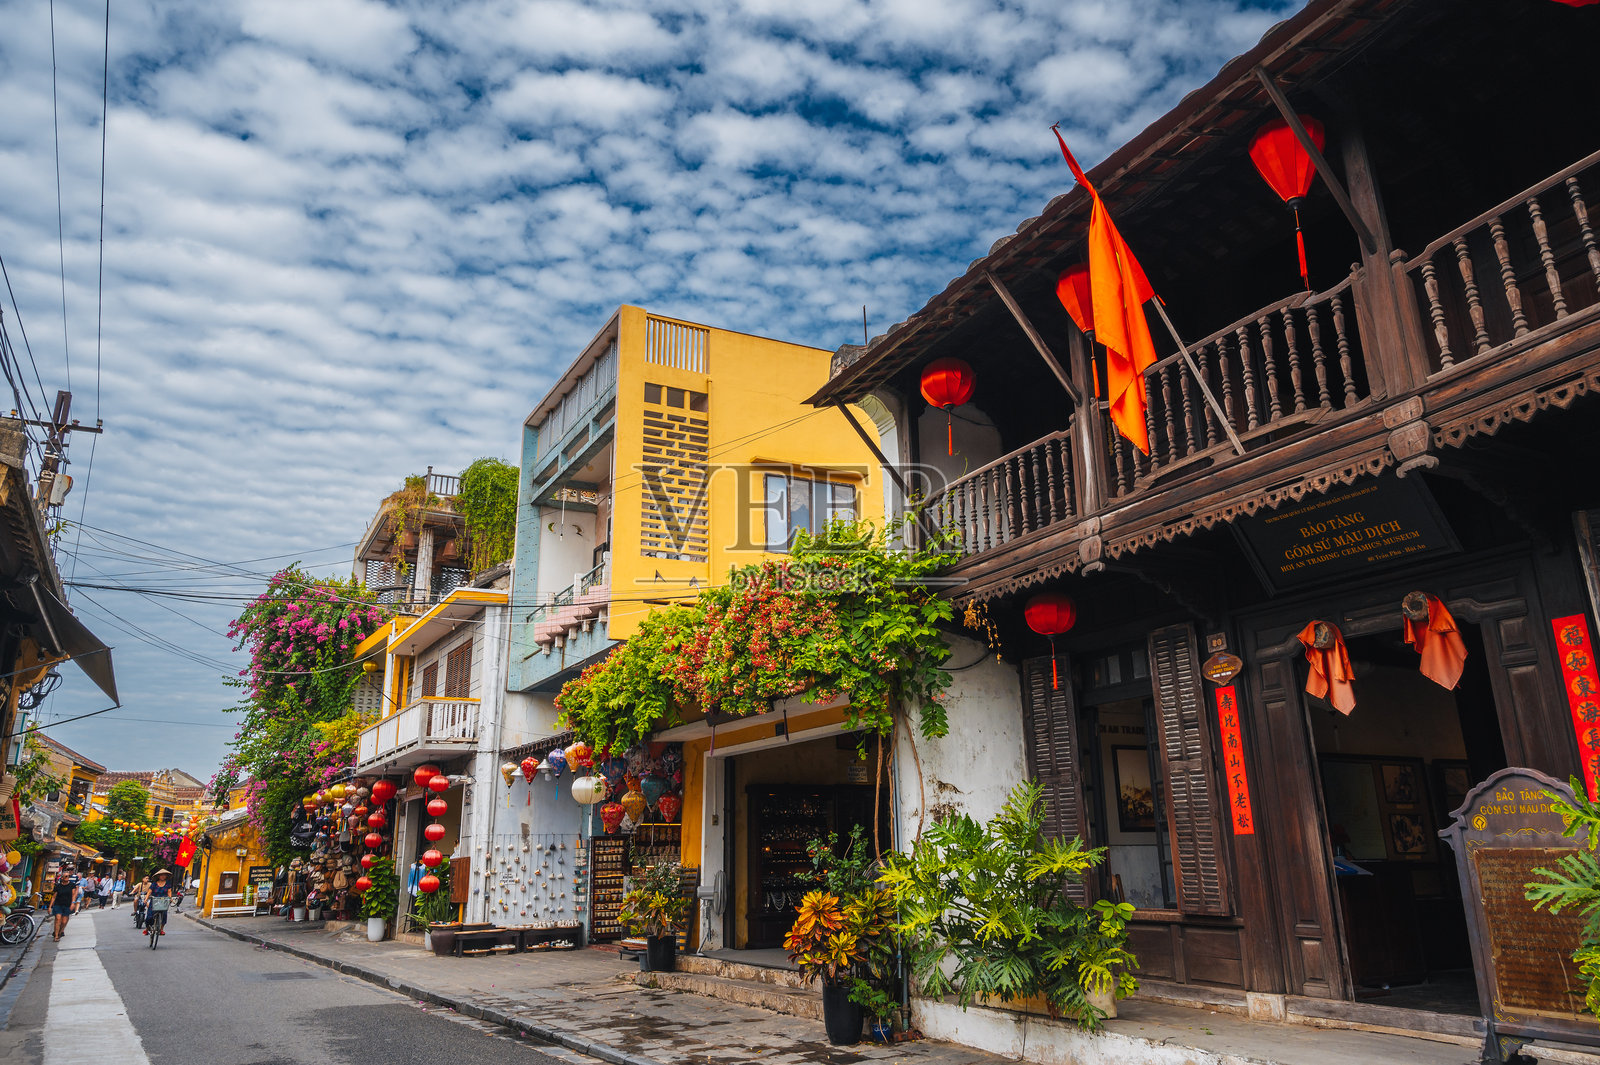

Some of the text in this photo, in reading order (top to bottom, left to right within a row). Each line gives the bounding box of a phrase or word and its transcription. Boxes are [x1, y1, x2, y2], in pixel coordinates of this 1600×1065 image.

[1300, 521, 1327, 538] BẢO
[1333, 529, 1363, 547] MẬU
[1365, 520, 1402, 539] DỊCH
[1306, 551, 1341, 566] TRADING
[1341, 540, 1382, 557] CERAMICS
[1383, 530, 1421, 546] MUSEUM
[1496, 787, 1514, 801] BẢO
